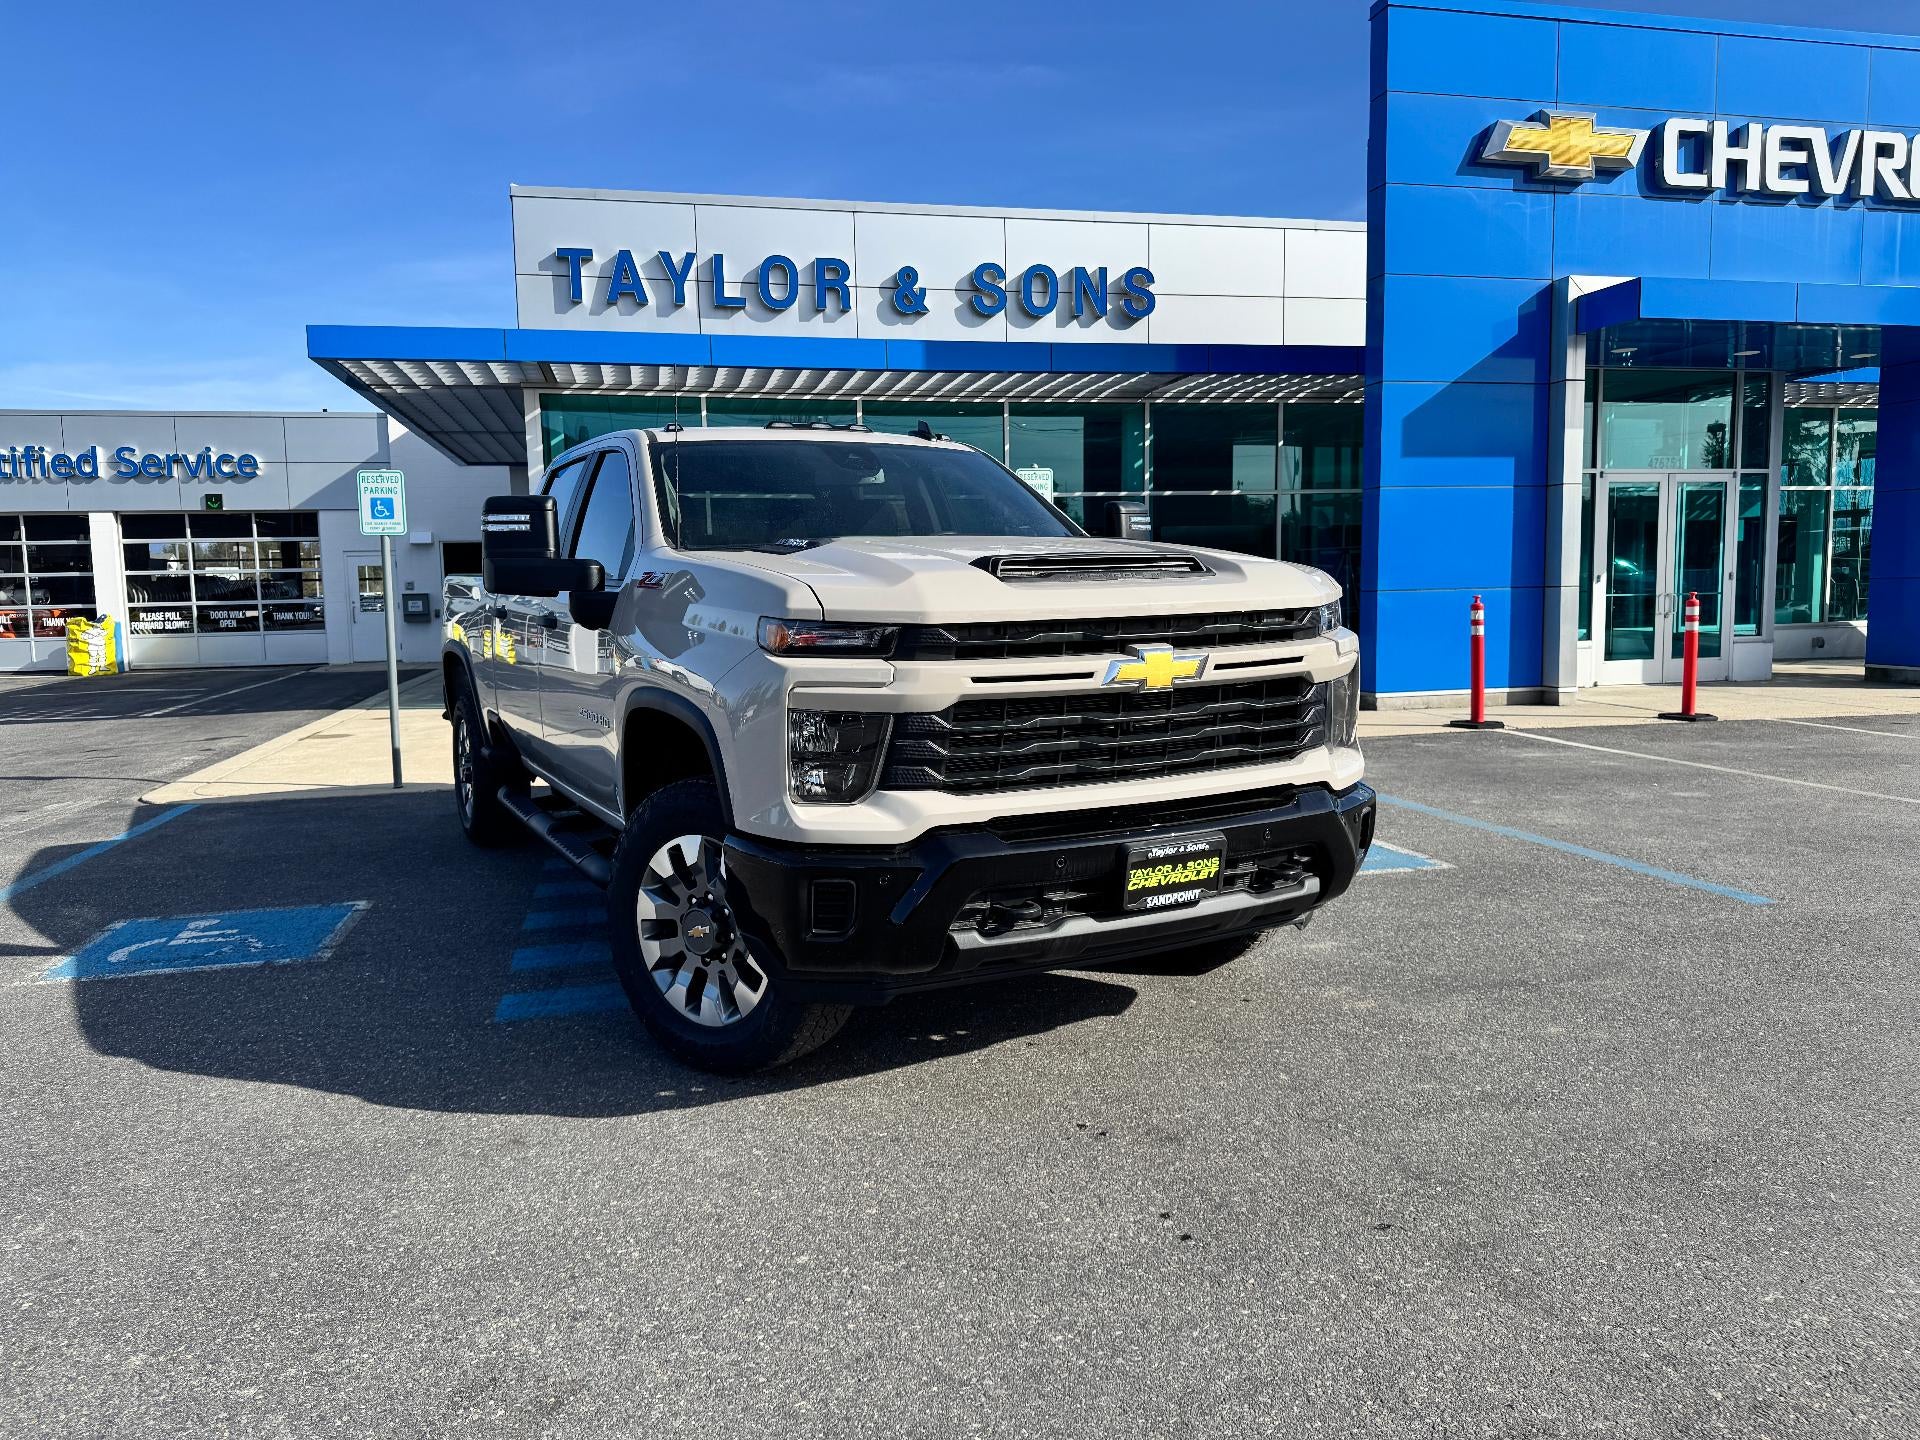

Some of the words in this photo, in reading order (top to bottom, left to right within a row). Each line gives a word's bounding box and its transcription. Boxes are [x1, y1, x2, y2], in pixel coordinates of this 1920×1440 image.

[1664, 118, 1920, 199] CHEVR
[556, 247, 851, 312] TAYLOR
[895, 265, 928, 314] &
[972, 262, 1156, 319] SONS
[115, 446, 259, 478] Service
[361, 475, 399, 484] RESERVED
[1019, 473, 1049, 481] RESERVED
[364, 486, 398, 495] PARKING
[139, 612, 164, 621] PLEASE
[165, 611, 182, 620] PULL
[210, 611, 228, 619] DOOR
[229, 610, 245, 618] WILL
[273, 612, 293, 620] THANK
[295, 611, 310, 619] YOU!
[42, 617, 66, 627] THANK
[131, 621, 163, 630] FORWARD
[164, 620, 190, 629] SLOWLY
[219, 619, 237, 627] OPEN
[1152, 846, 1178, 858] Taylor
[1129, 864, 1173, 880] TAYLOR
[1174, 863, 1184, 874] &
[1186, 856, 1220, 871] SONS
[1127, 868, 1218, 891] CHEVROLET
[1146, 889, 1201, 908] SANDPOINT
